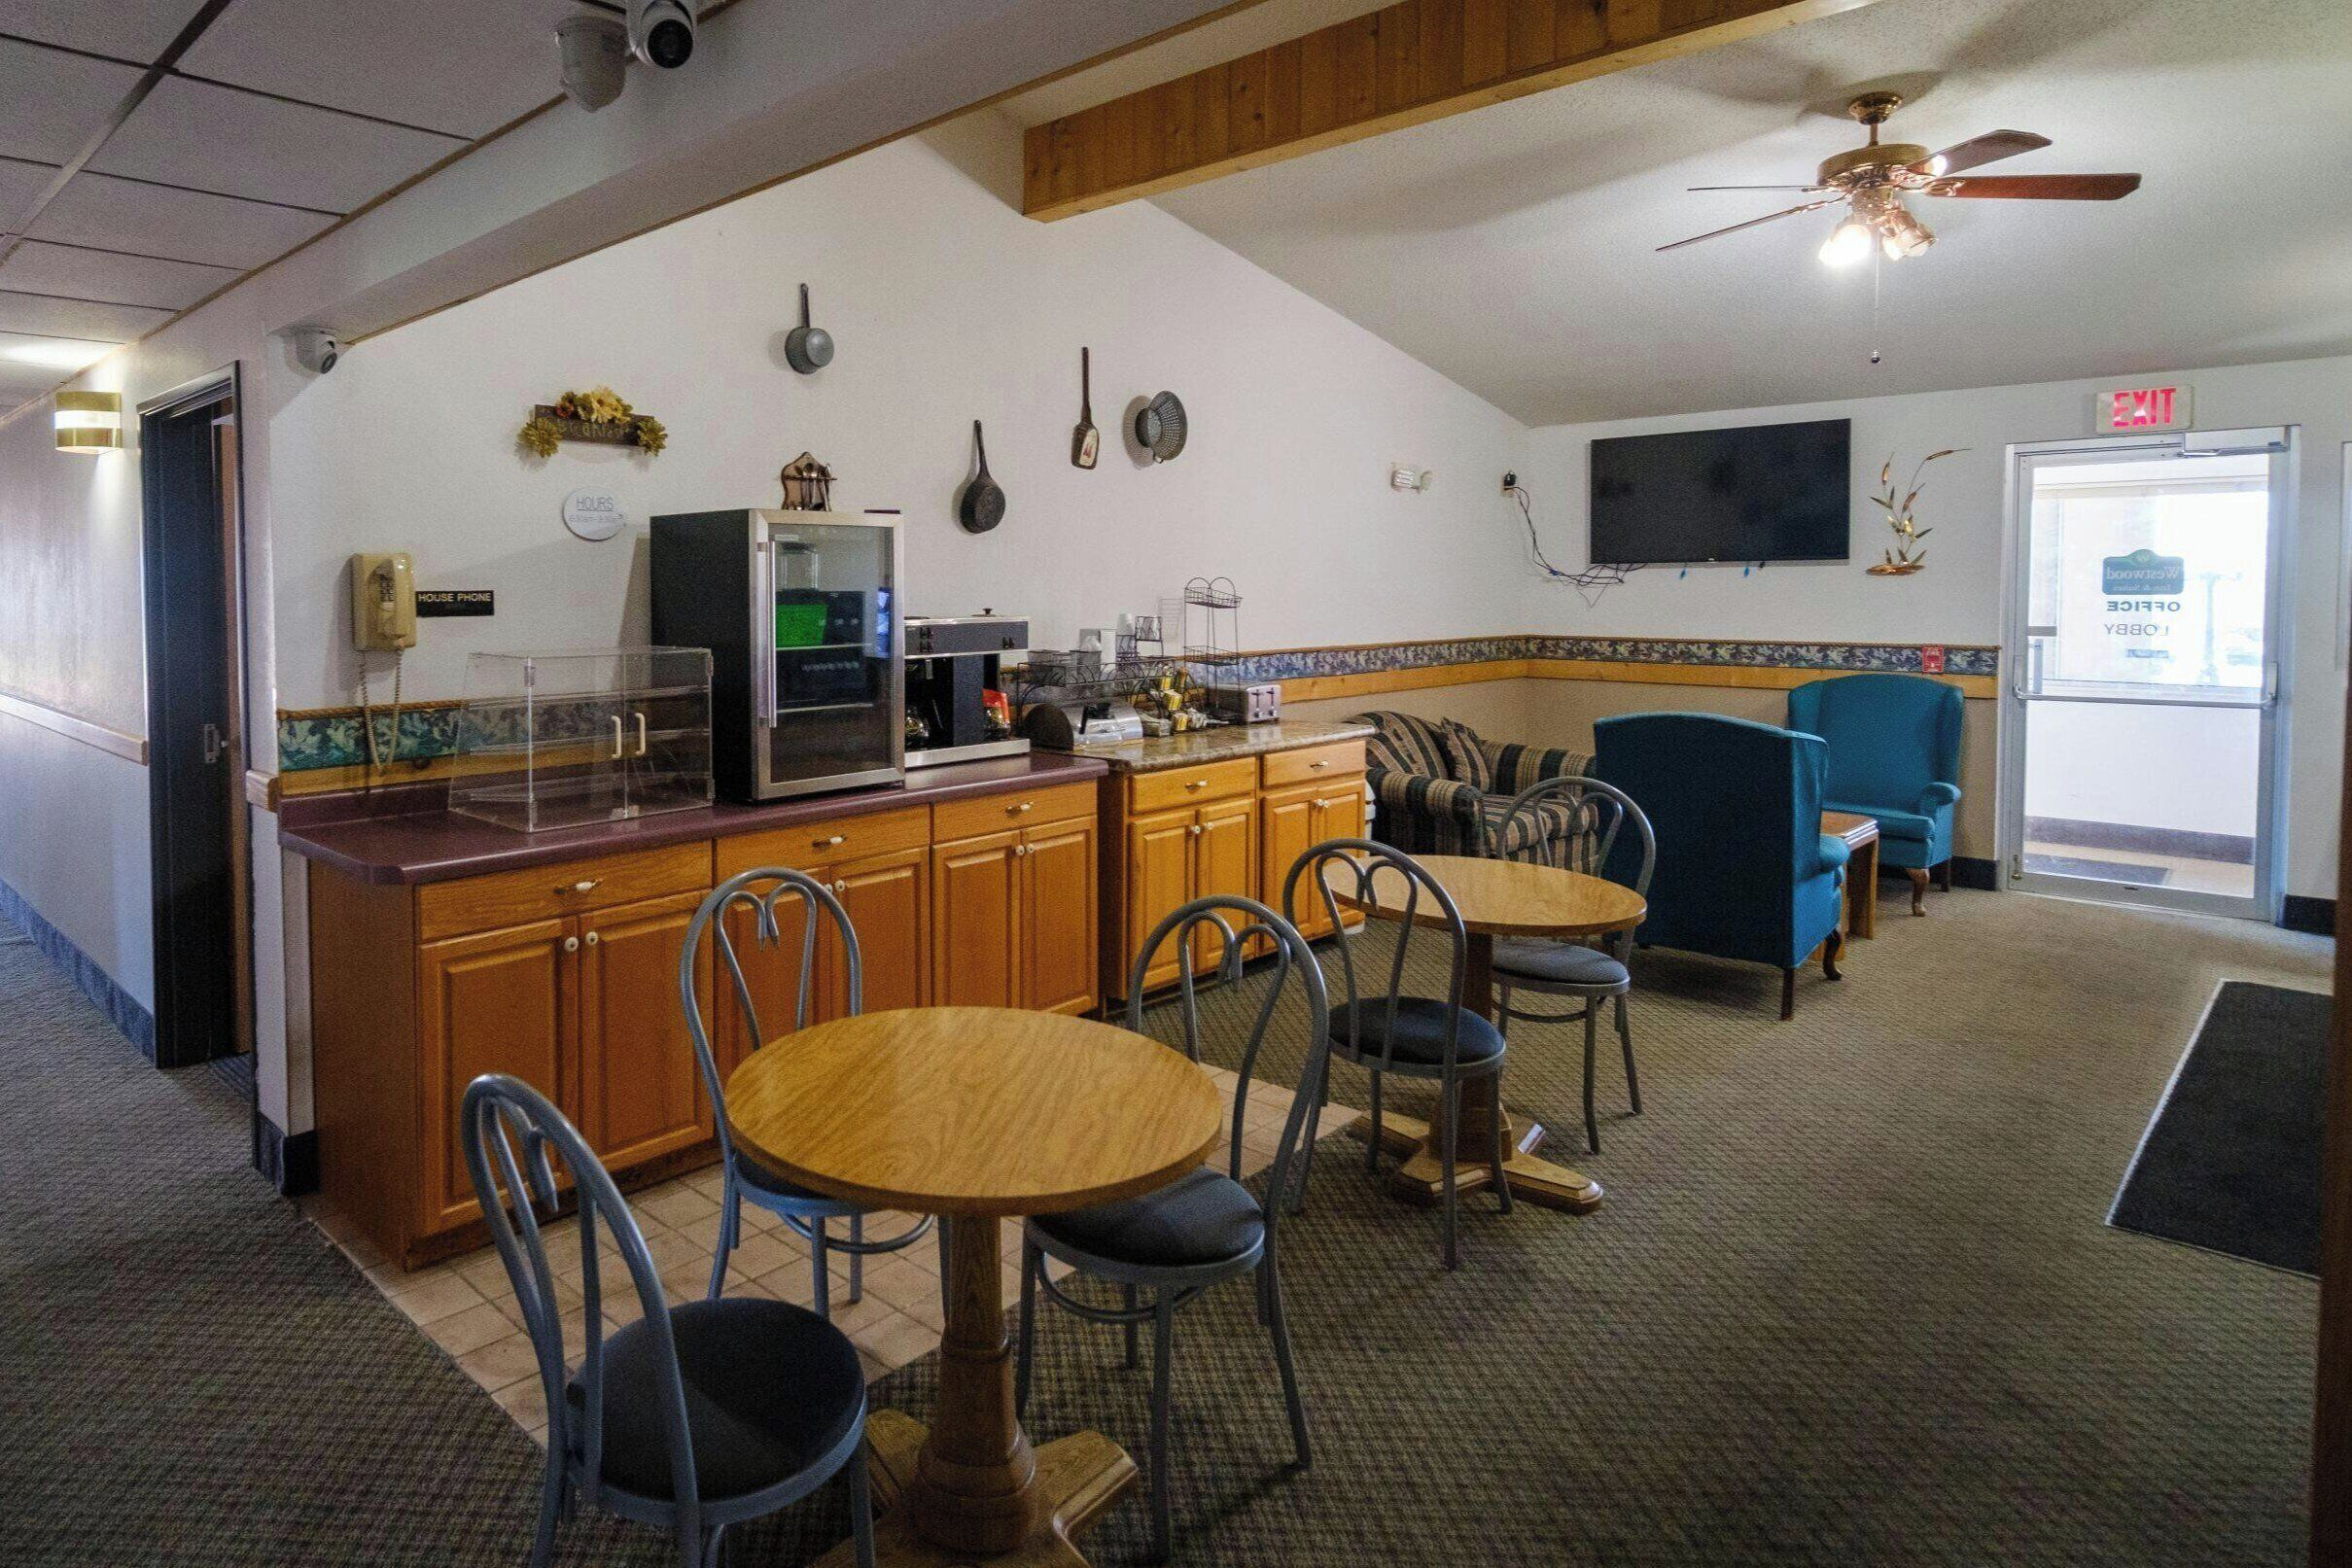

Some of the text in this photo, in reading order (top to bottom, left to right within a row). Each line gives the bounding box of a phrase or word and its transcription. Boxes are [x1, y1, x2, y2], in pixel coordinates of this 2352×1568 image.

[2113, 387, 2177, 428] EXIT
[576, 496, 614, 511] HOURS
[418, 592, 492, 602] HOUSE PHONE
